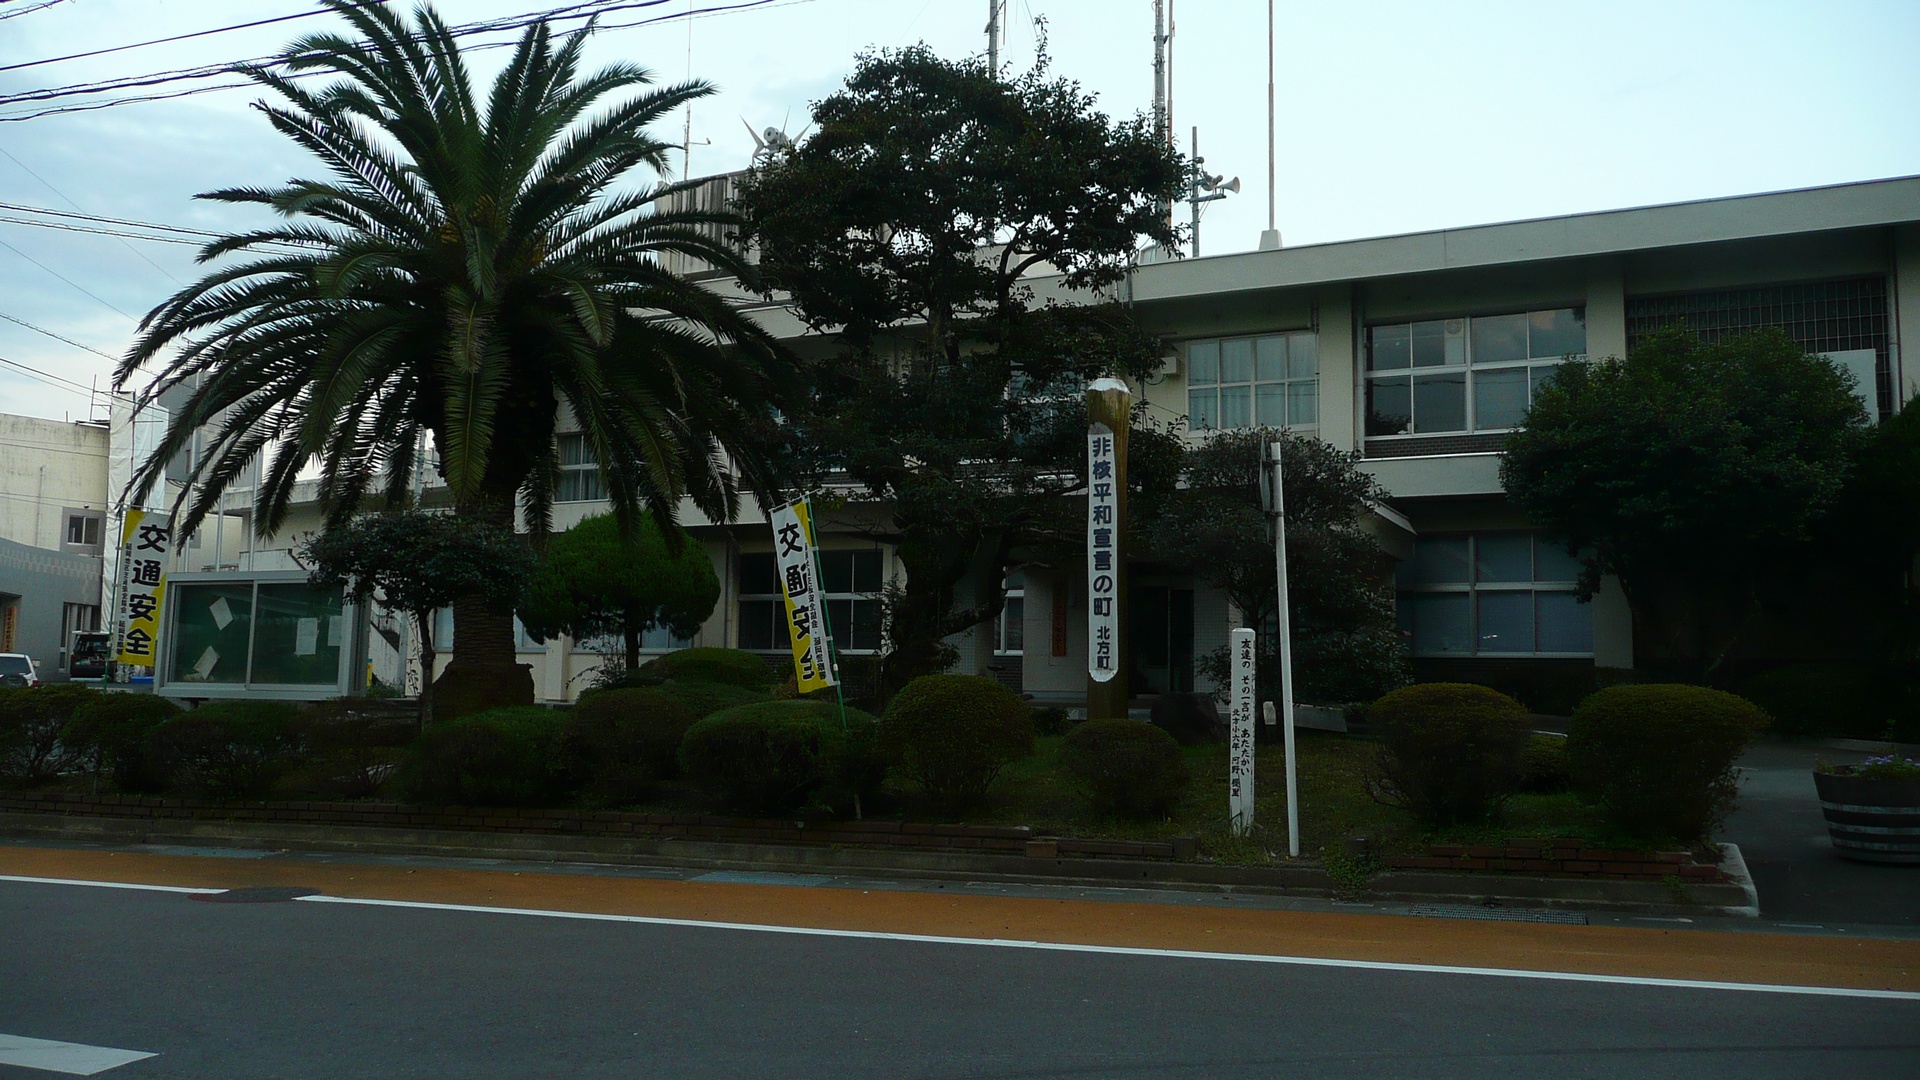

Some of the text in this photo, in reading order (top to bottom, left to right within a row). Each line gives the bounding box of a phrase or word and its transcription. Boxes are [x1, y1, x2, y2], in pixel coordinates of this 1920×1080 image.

[125, 524, 168, 656] 交通安全
[1092, 437, 1112, 669] 非核平和宣言の町 北方町
[1231, 708, 1240, 751] 北方小六年
[1240, 638, 1251, 776] 友達の その一言が あたたかい
